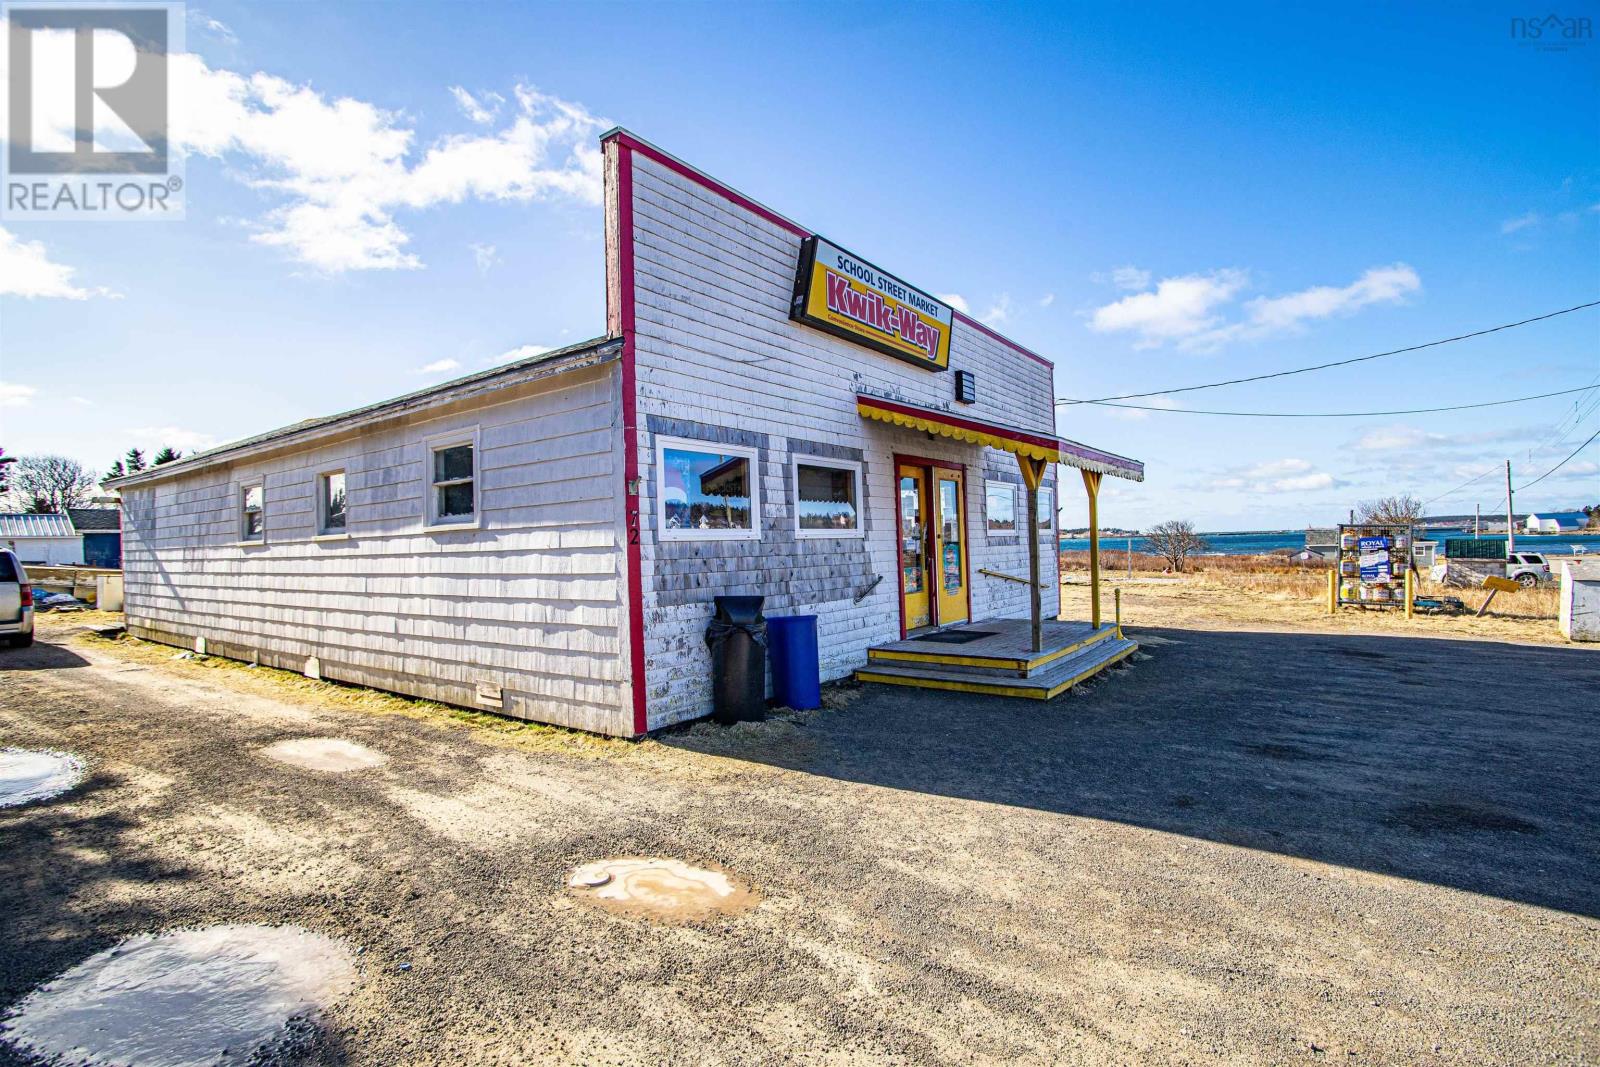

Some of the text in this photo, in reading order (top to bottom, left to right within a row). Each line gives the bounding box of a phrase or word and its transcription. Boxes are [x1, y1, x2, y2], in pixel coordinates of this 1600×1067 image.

[826, 269, 940, 361] Kwik-Way
[837, 255, 939, 318] SCHOOL STREET MARKET
